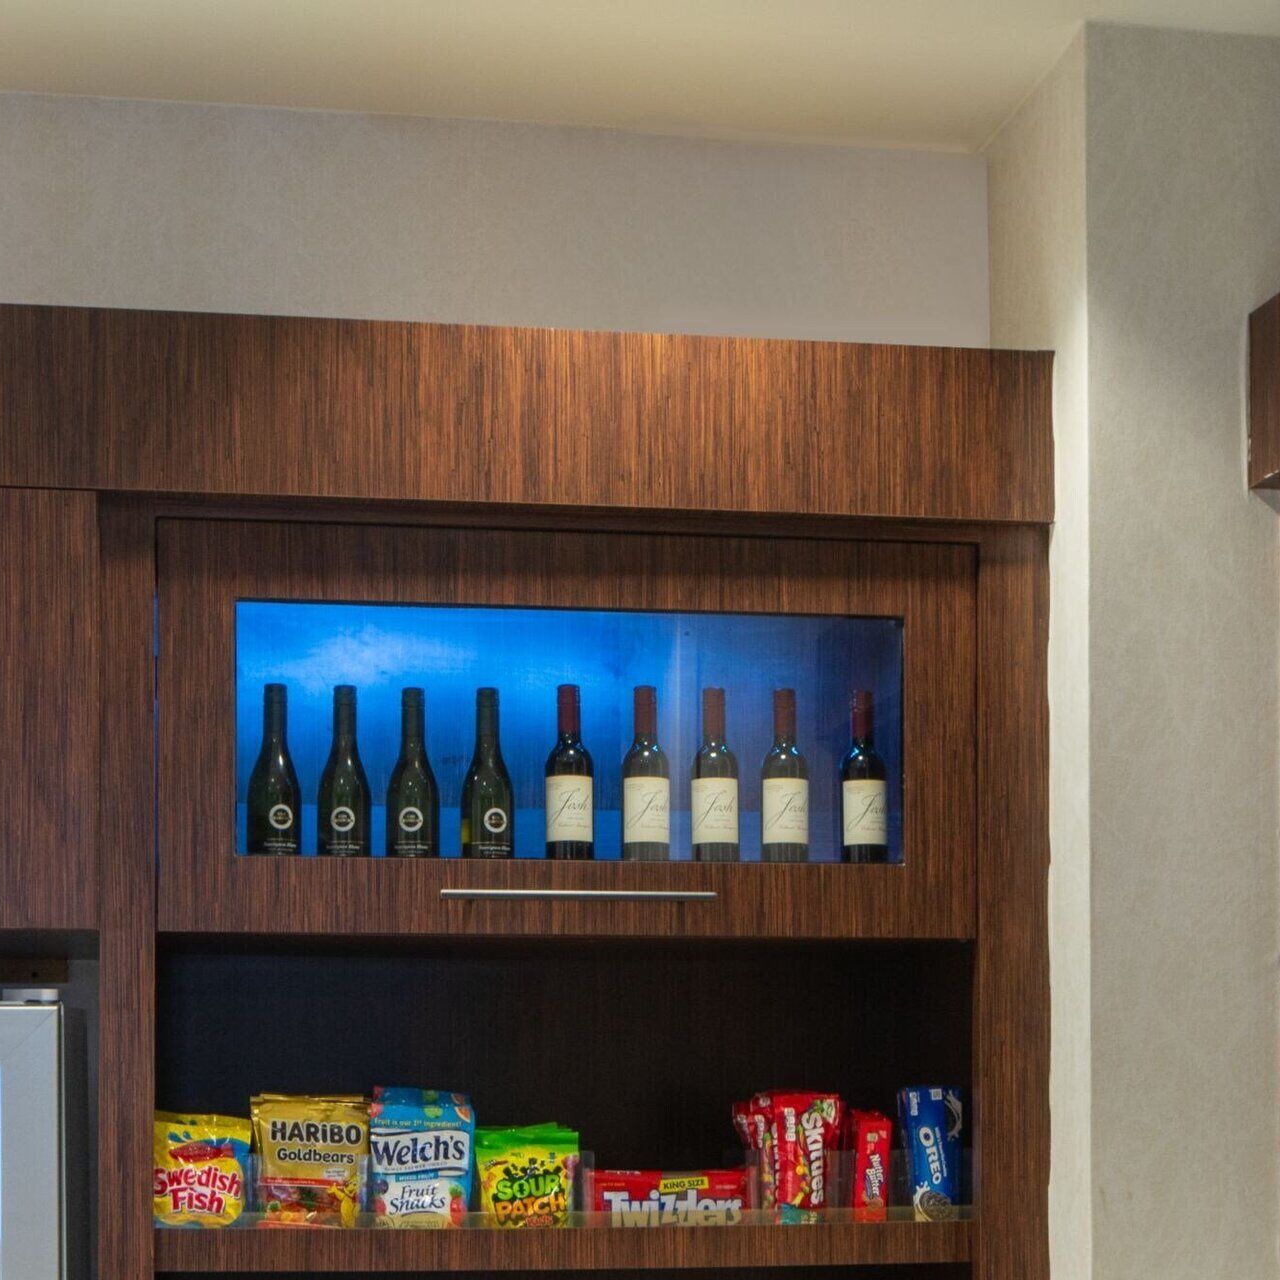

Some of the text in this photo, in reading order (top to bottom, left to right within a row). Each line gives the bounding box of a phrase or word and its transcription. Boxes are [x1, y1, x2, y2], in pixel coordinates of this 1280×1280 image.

[277, 1148, 355, 1165] Goldbears
[371, 1135, 465, 1167] Welch's
[919, 1126, 942, 1185] OREO
[154, 1165, 242, 1199] Swedish
[400, 1185, 437, 1199] Fruit
[496, 1176, 561, 1200] SOUR
[663, 1179, 705, 1190] KING SIZE
[171, 1188, 225, 1214] Fish
[389, 1196, 446, 1215] Snacks
[494, 1193, 567, 1222] PATCH
